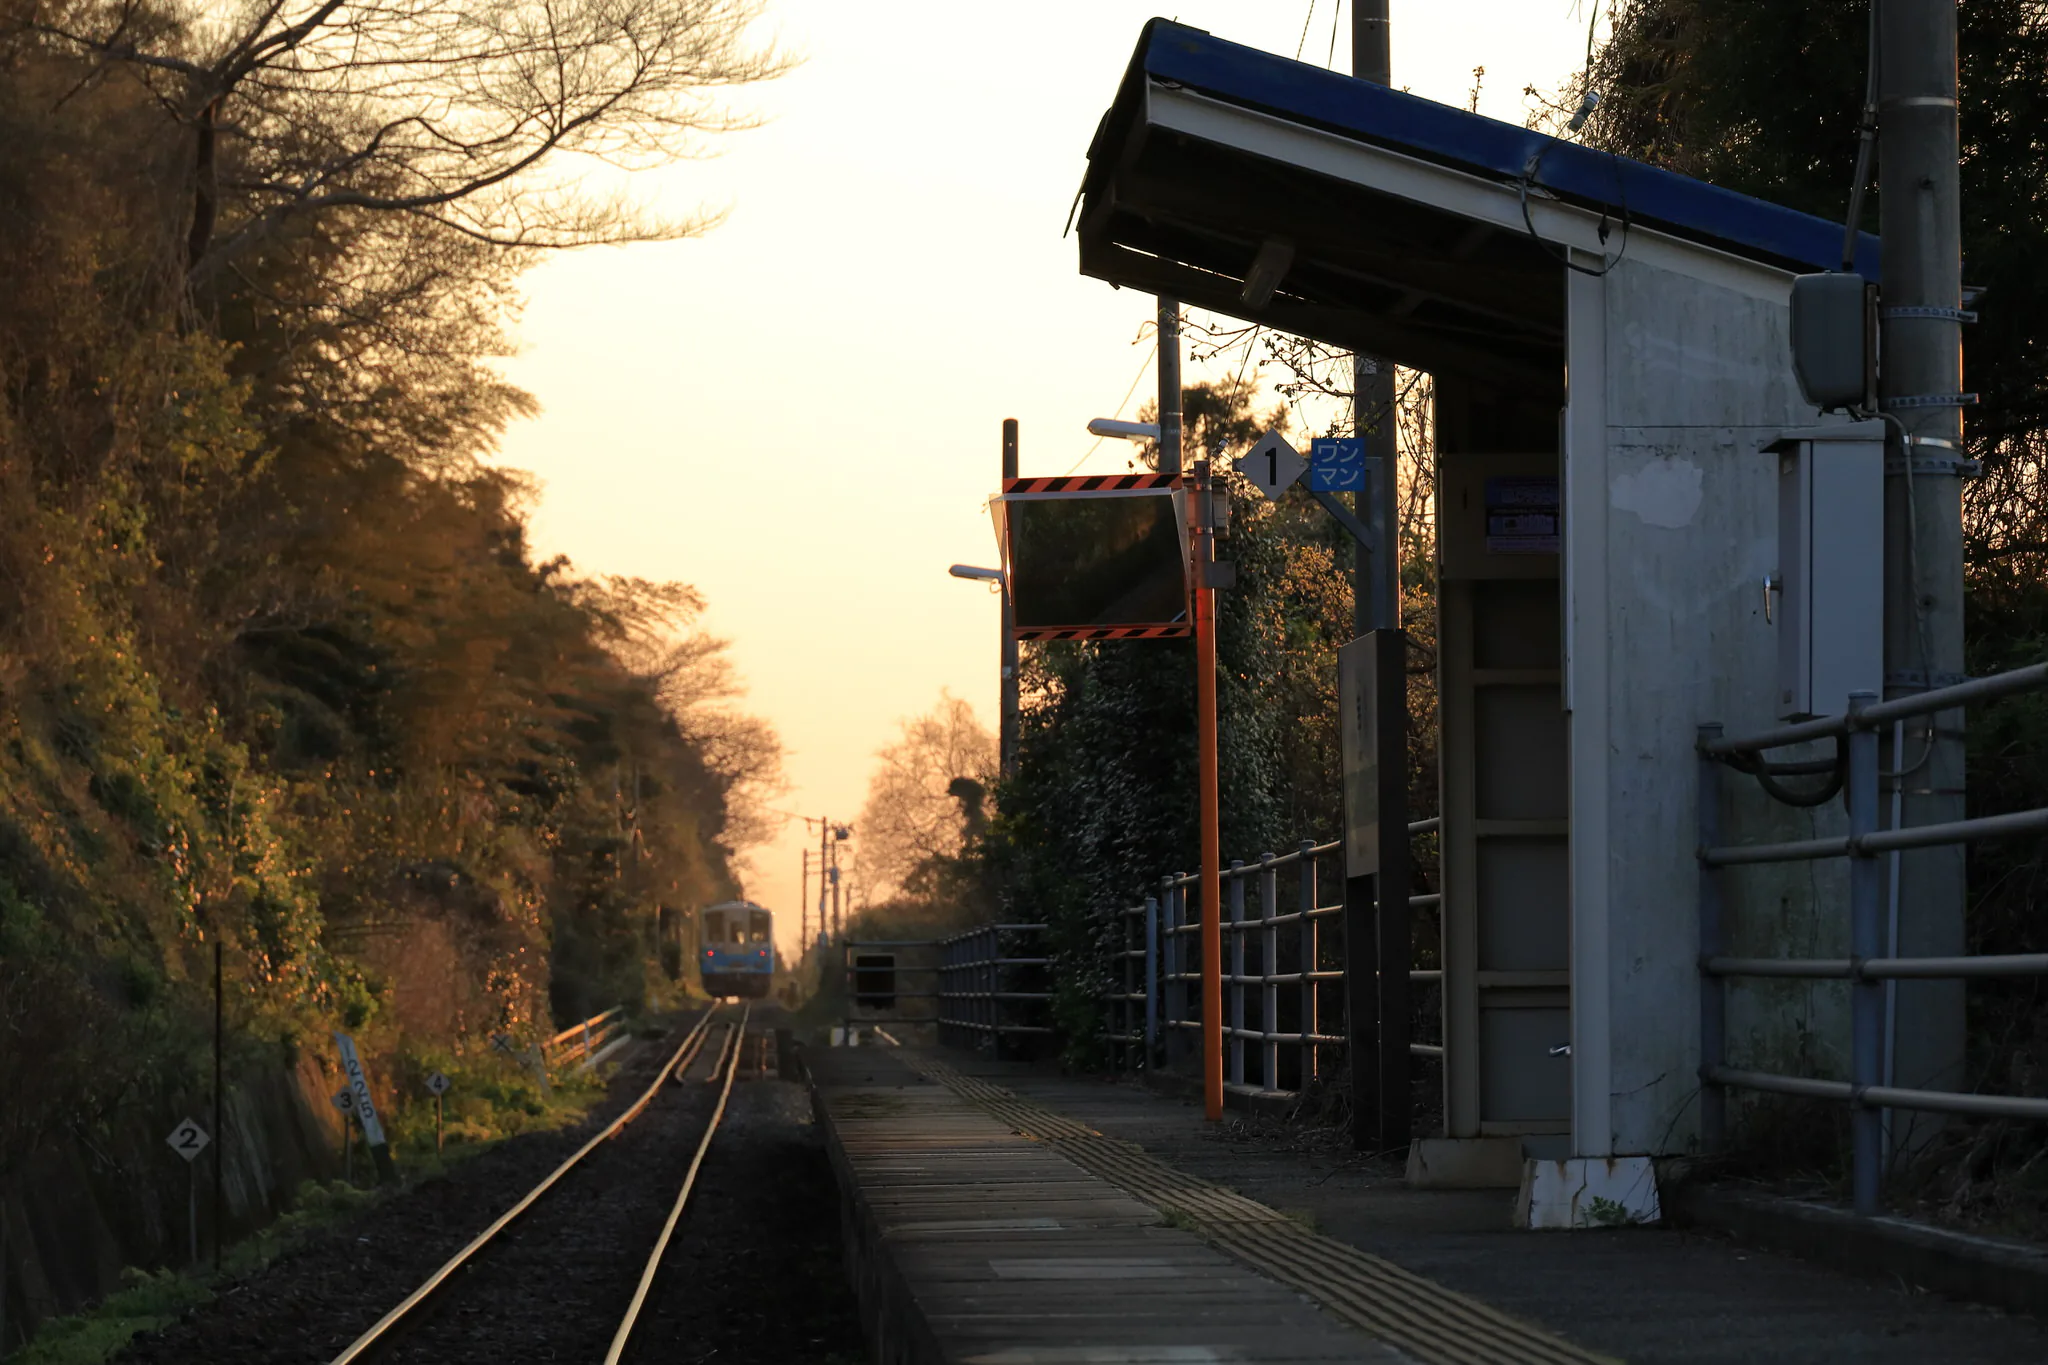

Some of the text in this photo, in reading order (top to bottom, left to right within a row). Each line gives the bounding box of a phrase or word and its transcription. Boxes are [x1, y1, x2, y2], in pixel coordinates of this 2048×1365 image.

[1317, 444, 1359, 463] ワン
[1265, 447, 1277, 486] 1
[1317, 467, 1359, 486] マン
[433, 1075, 443, 1091] 4
[340, 1092, 354, 1109] 3
[179, 1127, 200, 1149] 2
